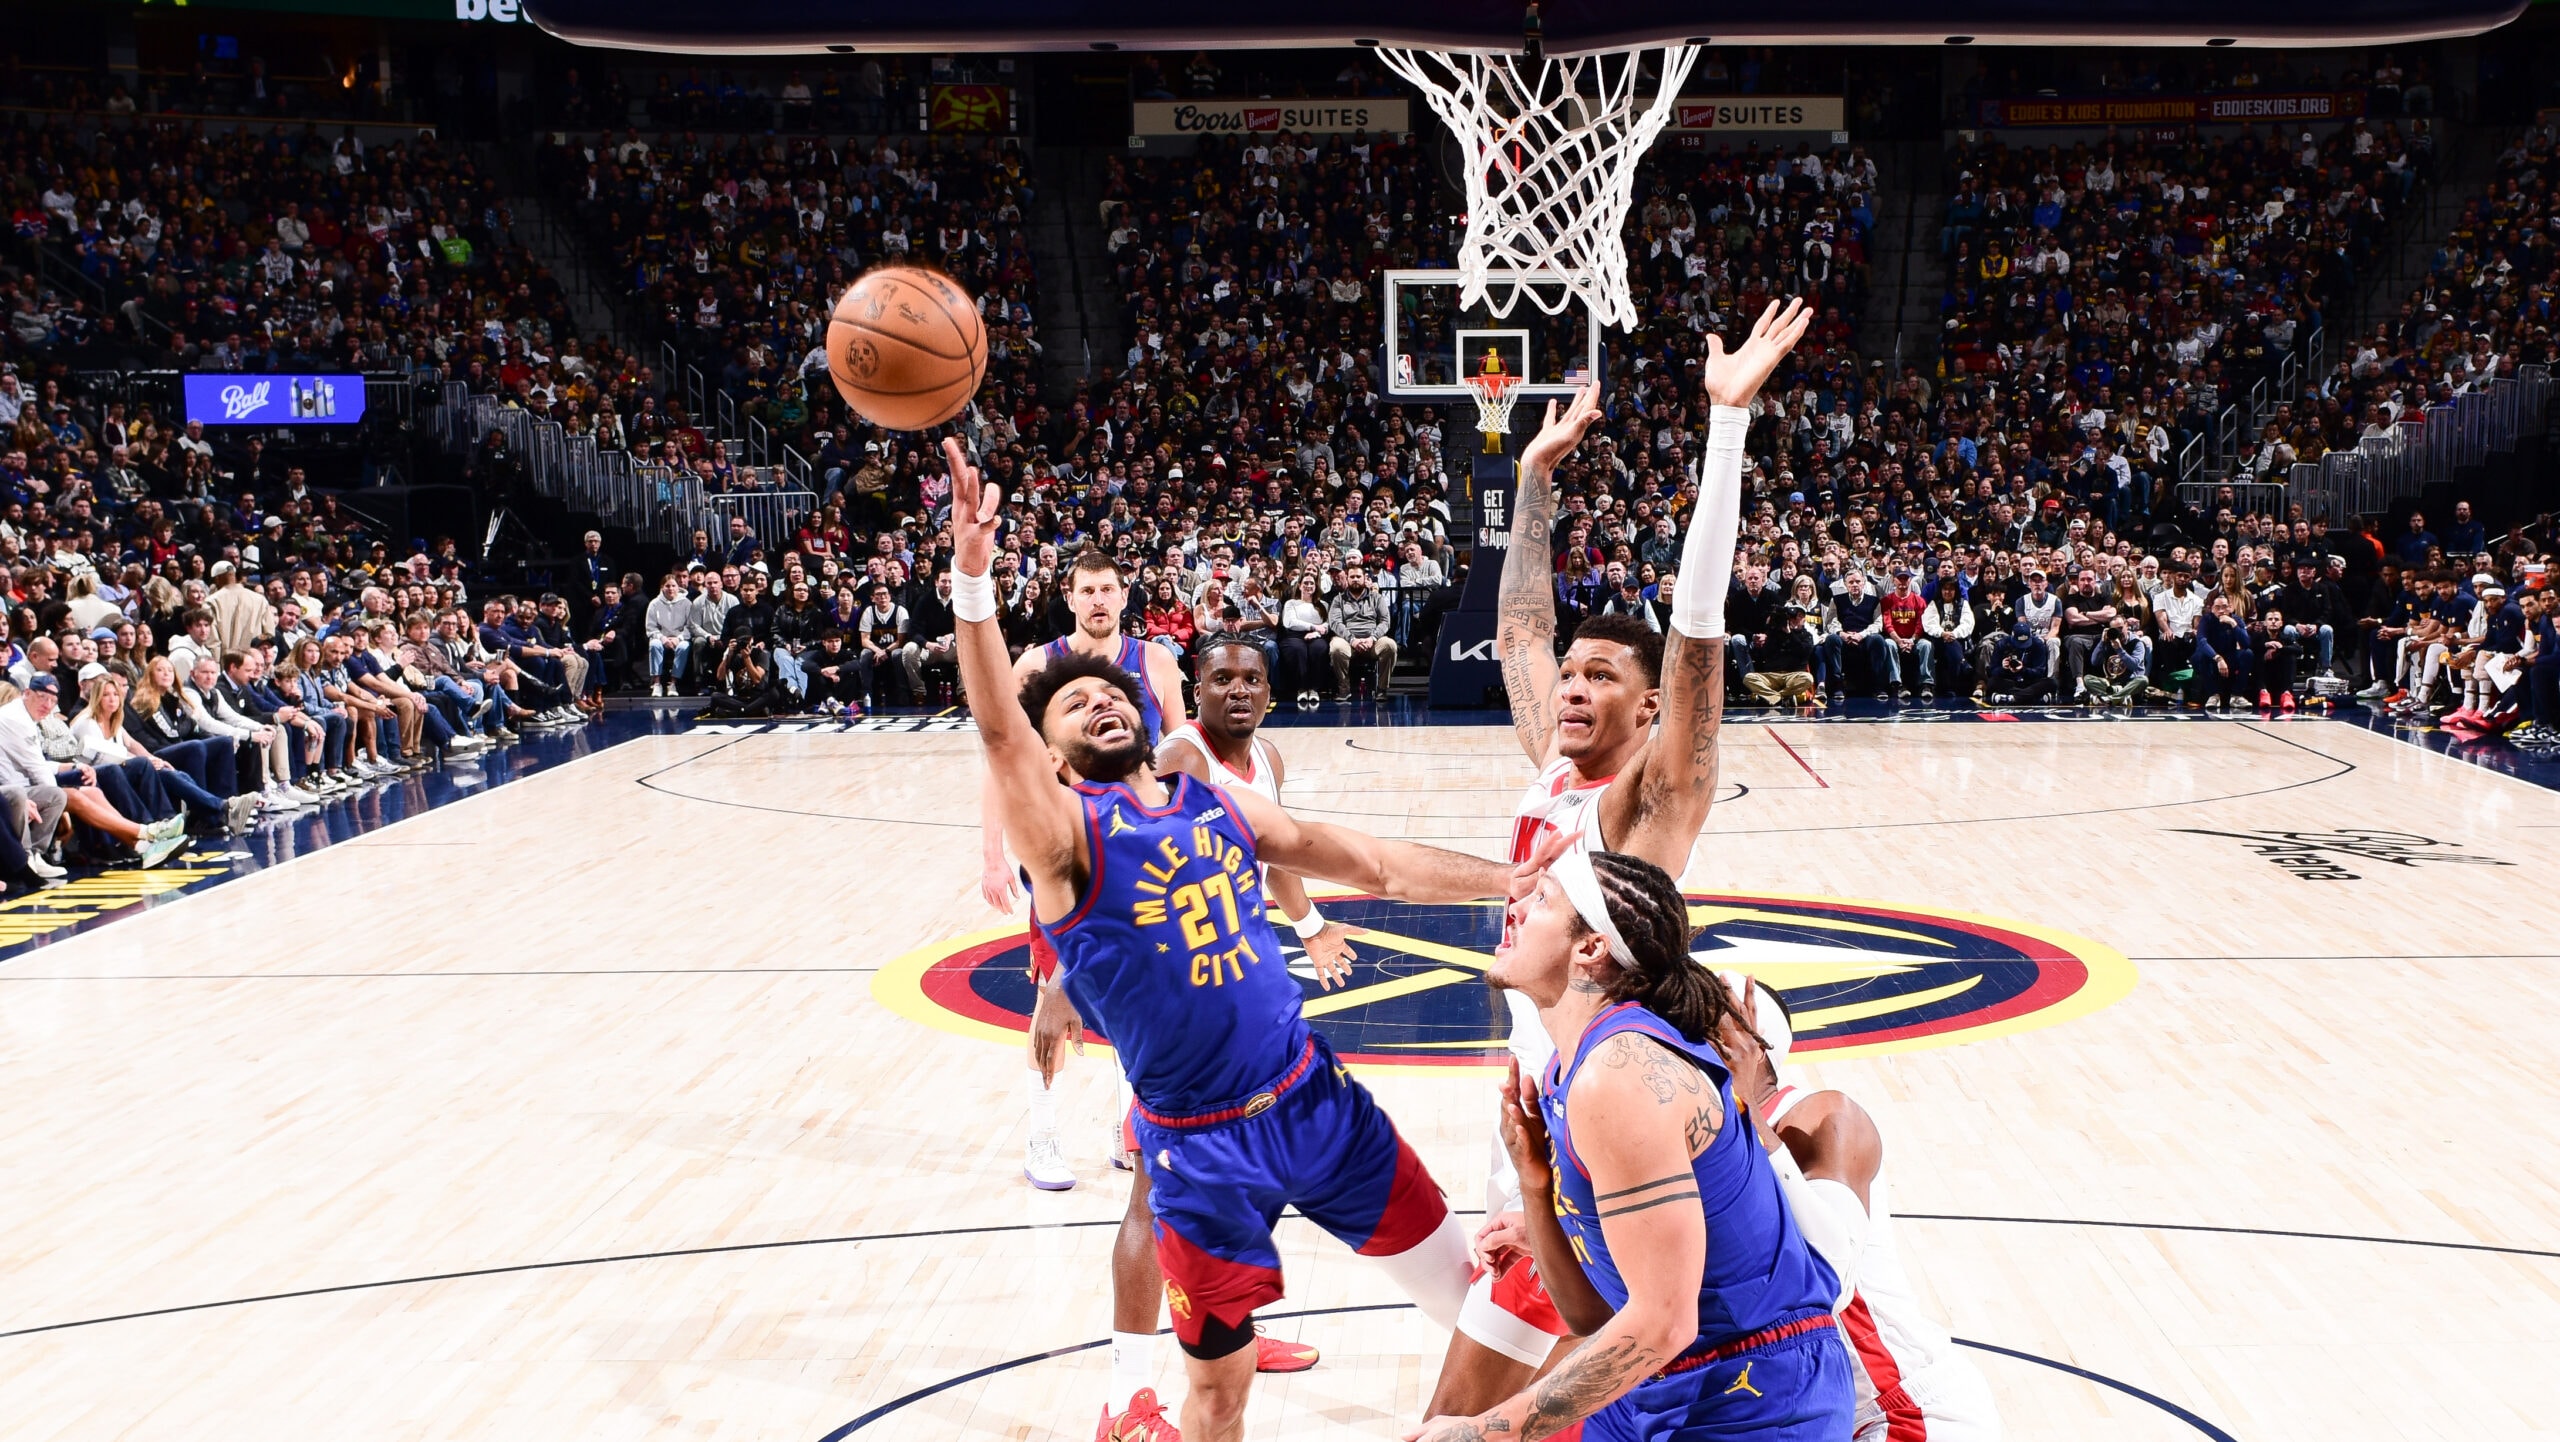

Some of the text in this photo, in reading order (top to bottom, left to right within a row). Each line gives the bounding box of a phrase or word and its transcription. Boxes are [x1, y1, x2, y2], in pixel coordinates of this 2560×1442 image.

[456, 0, 534, 23] be
[1174, 105, 1369, 131] Coors Banquet SUITES
[1682, 107, 1713, 126] Banquet
[1718, 106, 1803, 124] SUITES
[2009, 104, 2062, 121] EDDIE'S
[2067, 104, 2100, 120] KIDS
[2105, 101, 2195, 120] FOUNDATION
[2212, 98, 2329, 116] EDDIESKIDS.ORG
[1680, 136, 1700, 147] 138
[2155, 131, 2175, 141] 140
[220, 380, 270, 419] Ball
[1484, 489, 1505, 508] GET
[1484, 508, 1505, 526] THE
[1488, 527, 1510, 550] App
[1450, 639, 1500, 661] KI
[1503, 626, 1527, 703] MEDIOCRITY
[1517, 705, 1531, 729] And
[2043, 713, 2332, 721] ULTRA
[682, 723, 980, 735] NUGG
[2240, 843, 2362, 881] Arena
[1133, 826, 1256, 927] MILE HIGH
[1170, 870, 1241, 951] 27
[1189, 934, 1260, 988] CITY
